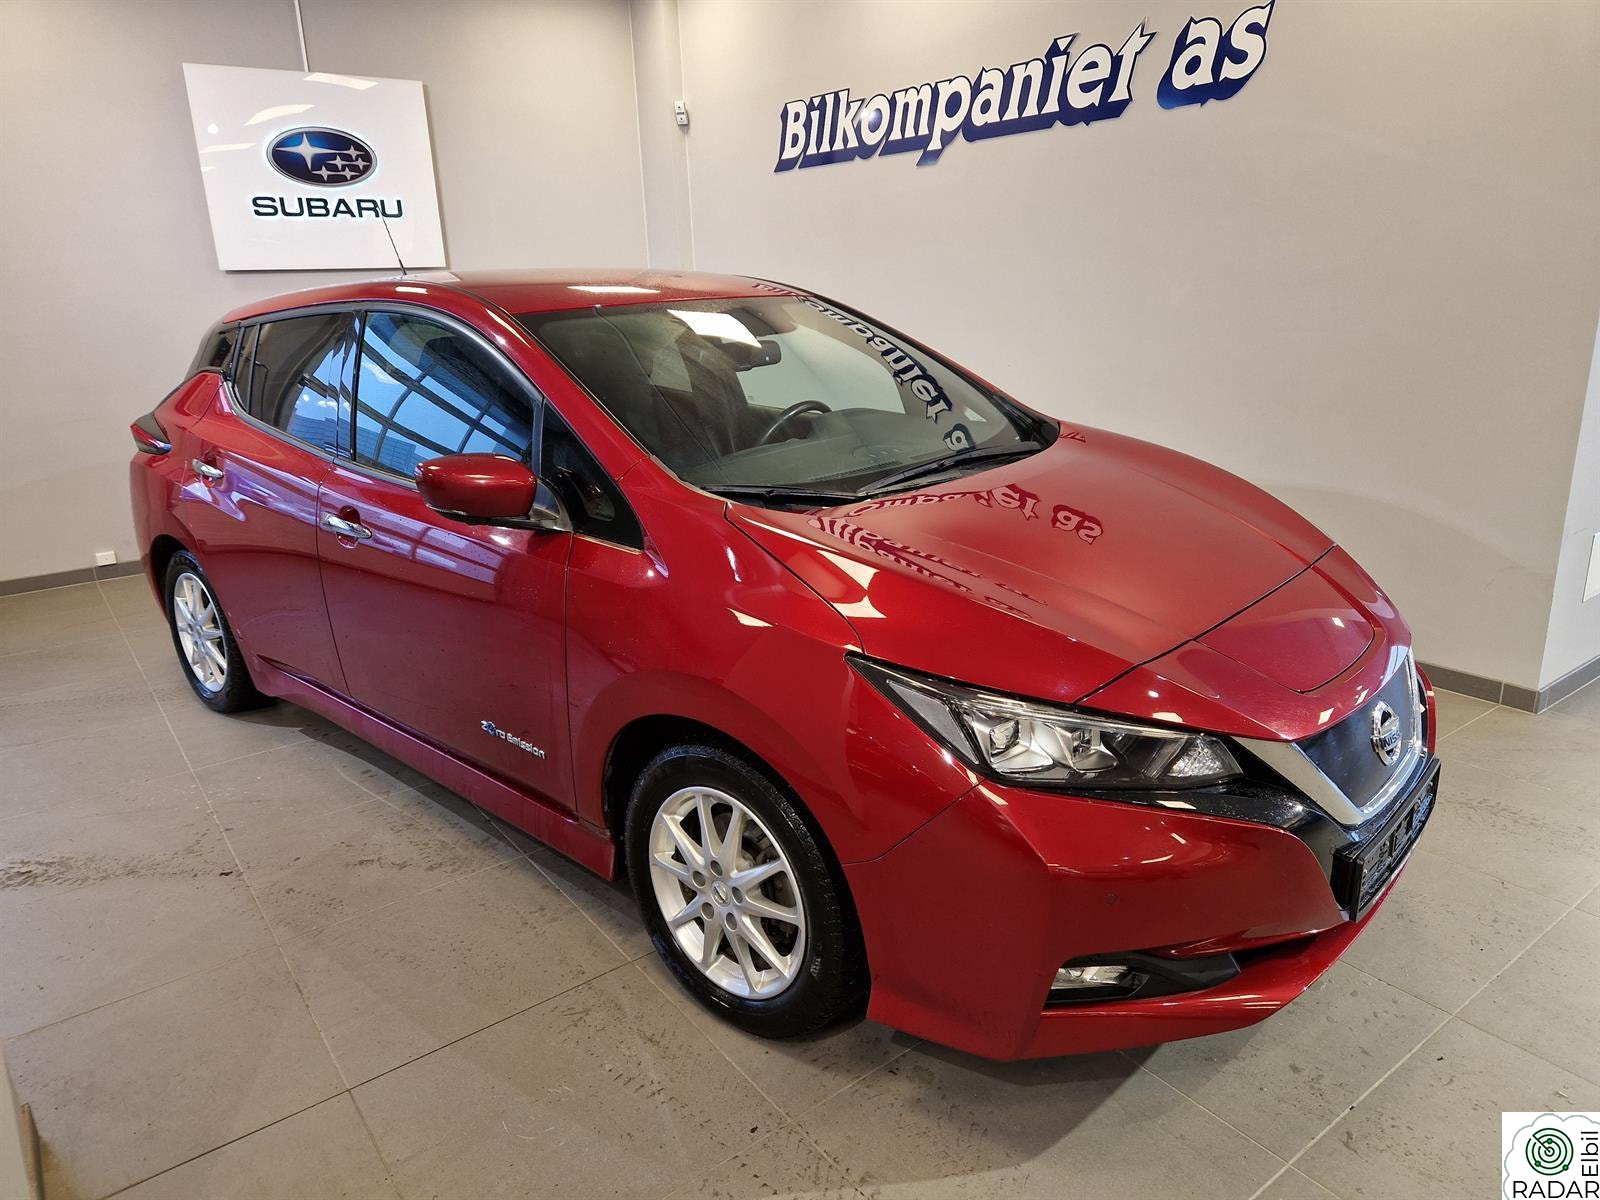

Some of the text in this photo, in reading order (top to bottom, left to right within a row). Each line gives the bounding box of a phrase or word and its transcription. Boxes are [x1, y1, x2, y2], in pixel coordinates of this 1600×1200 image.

[775, 0, 1275, 171] Bilkompaniet as
[252, 196, 403, 218] SUBARU
[506, 733, 546, 760] Emission
